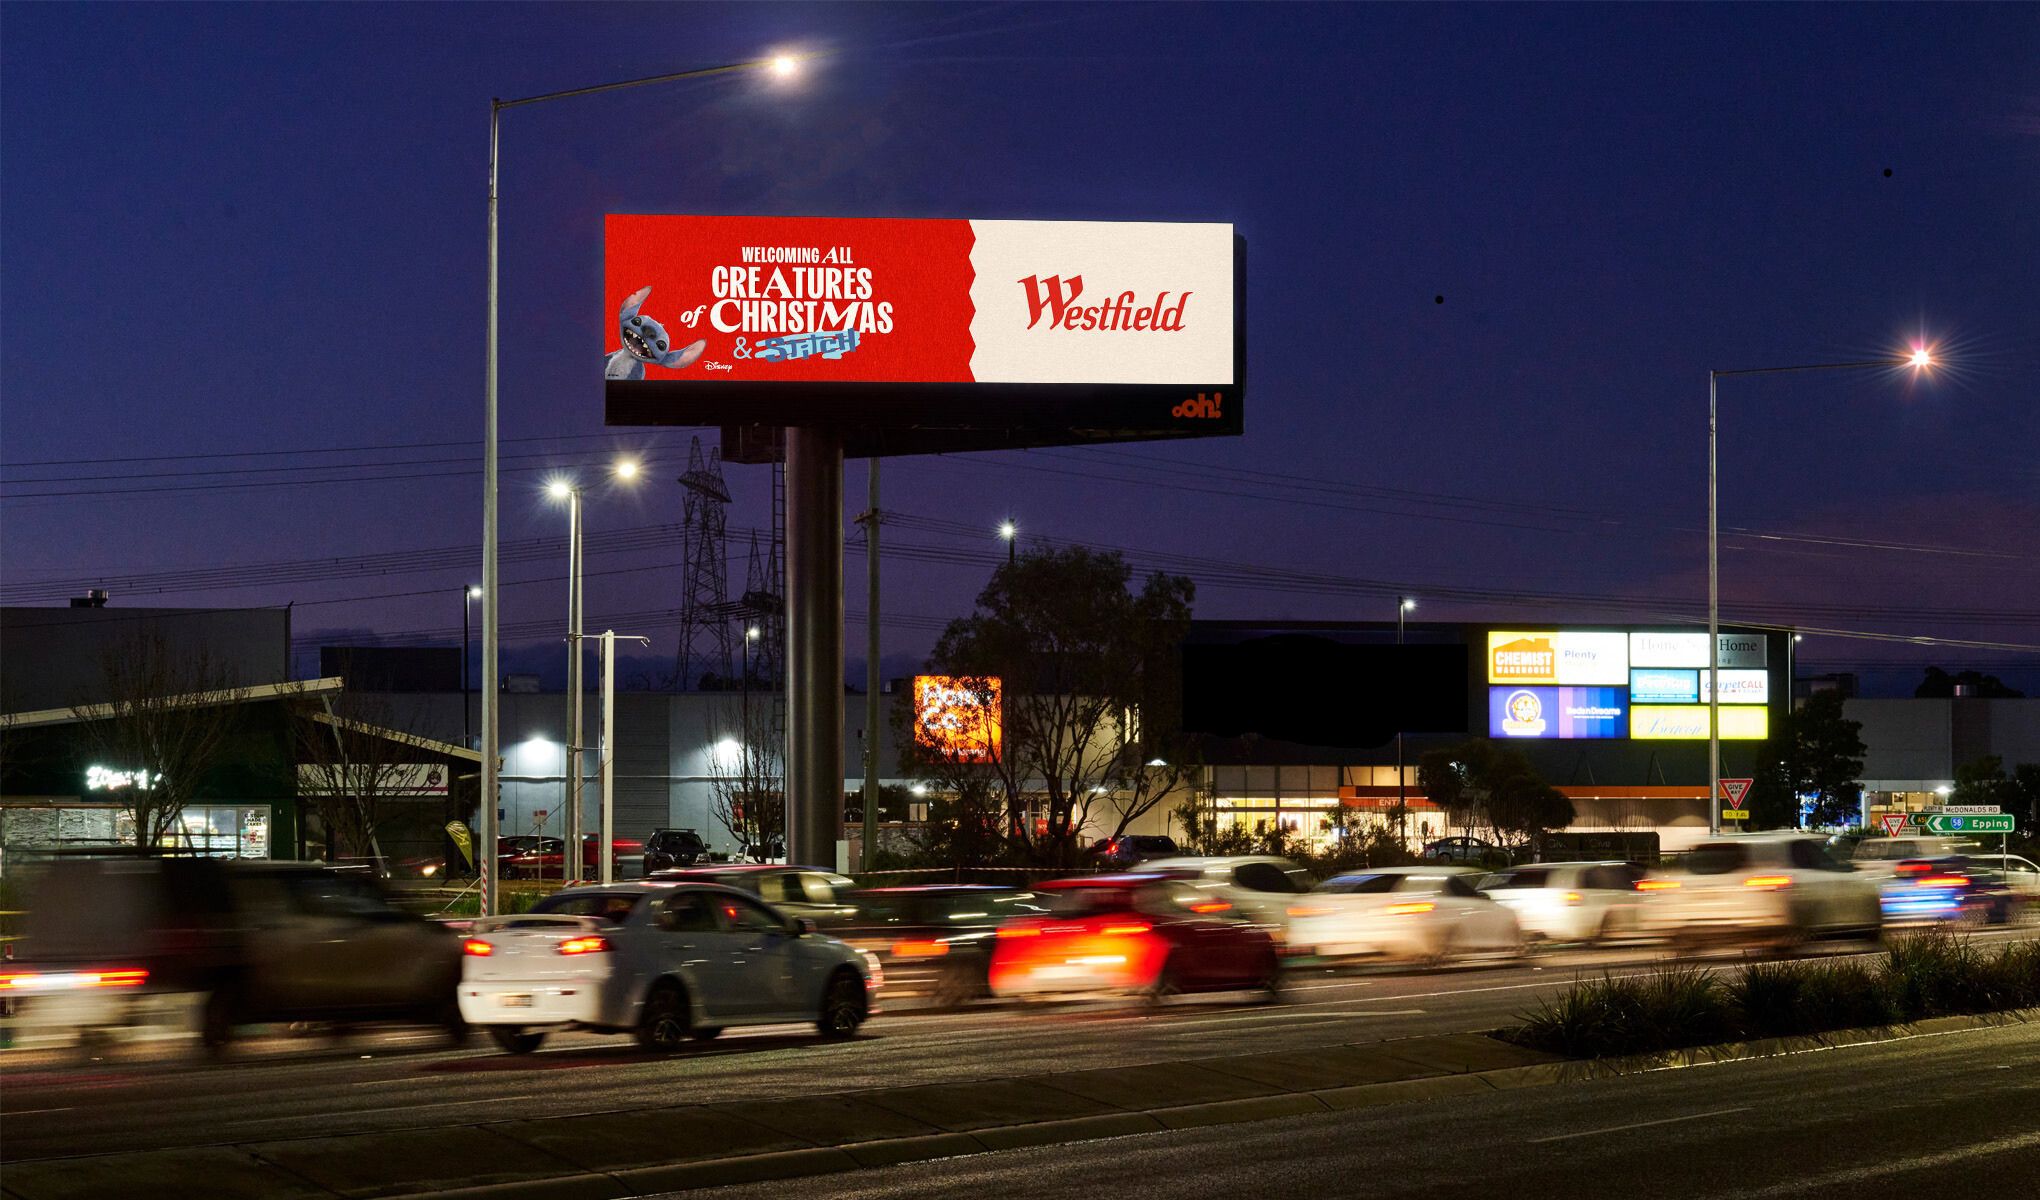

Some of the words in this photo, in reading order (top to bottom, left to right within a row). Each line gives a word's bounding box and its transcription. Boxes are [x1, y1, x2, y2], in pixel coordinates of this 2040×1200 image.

[742, 246, 819, 263] WELCOMING
[822, 246, 853, 264] ALL
[711, 265, 873, 300] CREATURES
[1017, 274, 1194, 332] Westfield
[680, 305, 707, 329] of
[710, 298, 894, 333] CHRISTMAS
[733, 336, 753, 360] &
[703, 360, 733, 373] Disney
[1719, 638, 1757, 651] Home
[1495, 651, 1552, 666] CHEMIST
[1564, 649, 1597, 660] Plenty
[1379, 799, 1408, 807] ENTY
[1952, 817, 1962, 826] 58
[1972, 819, 2009, 830] Epping
